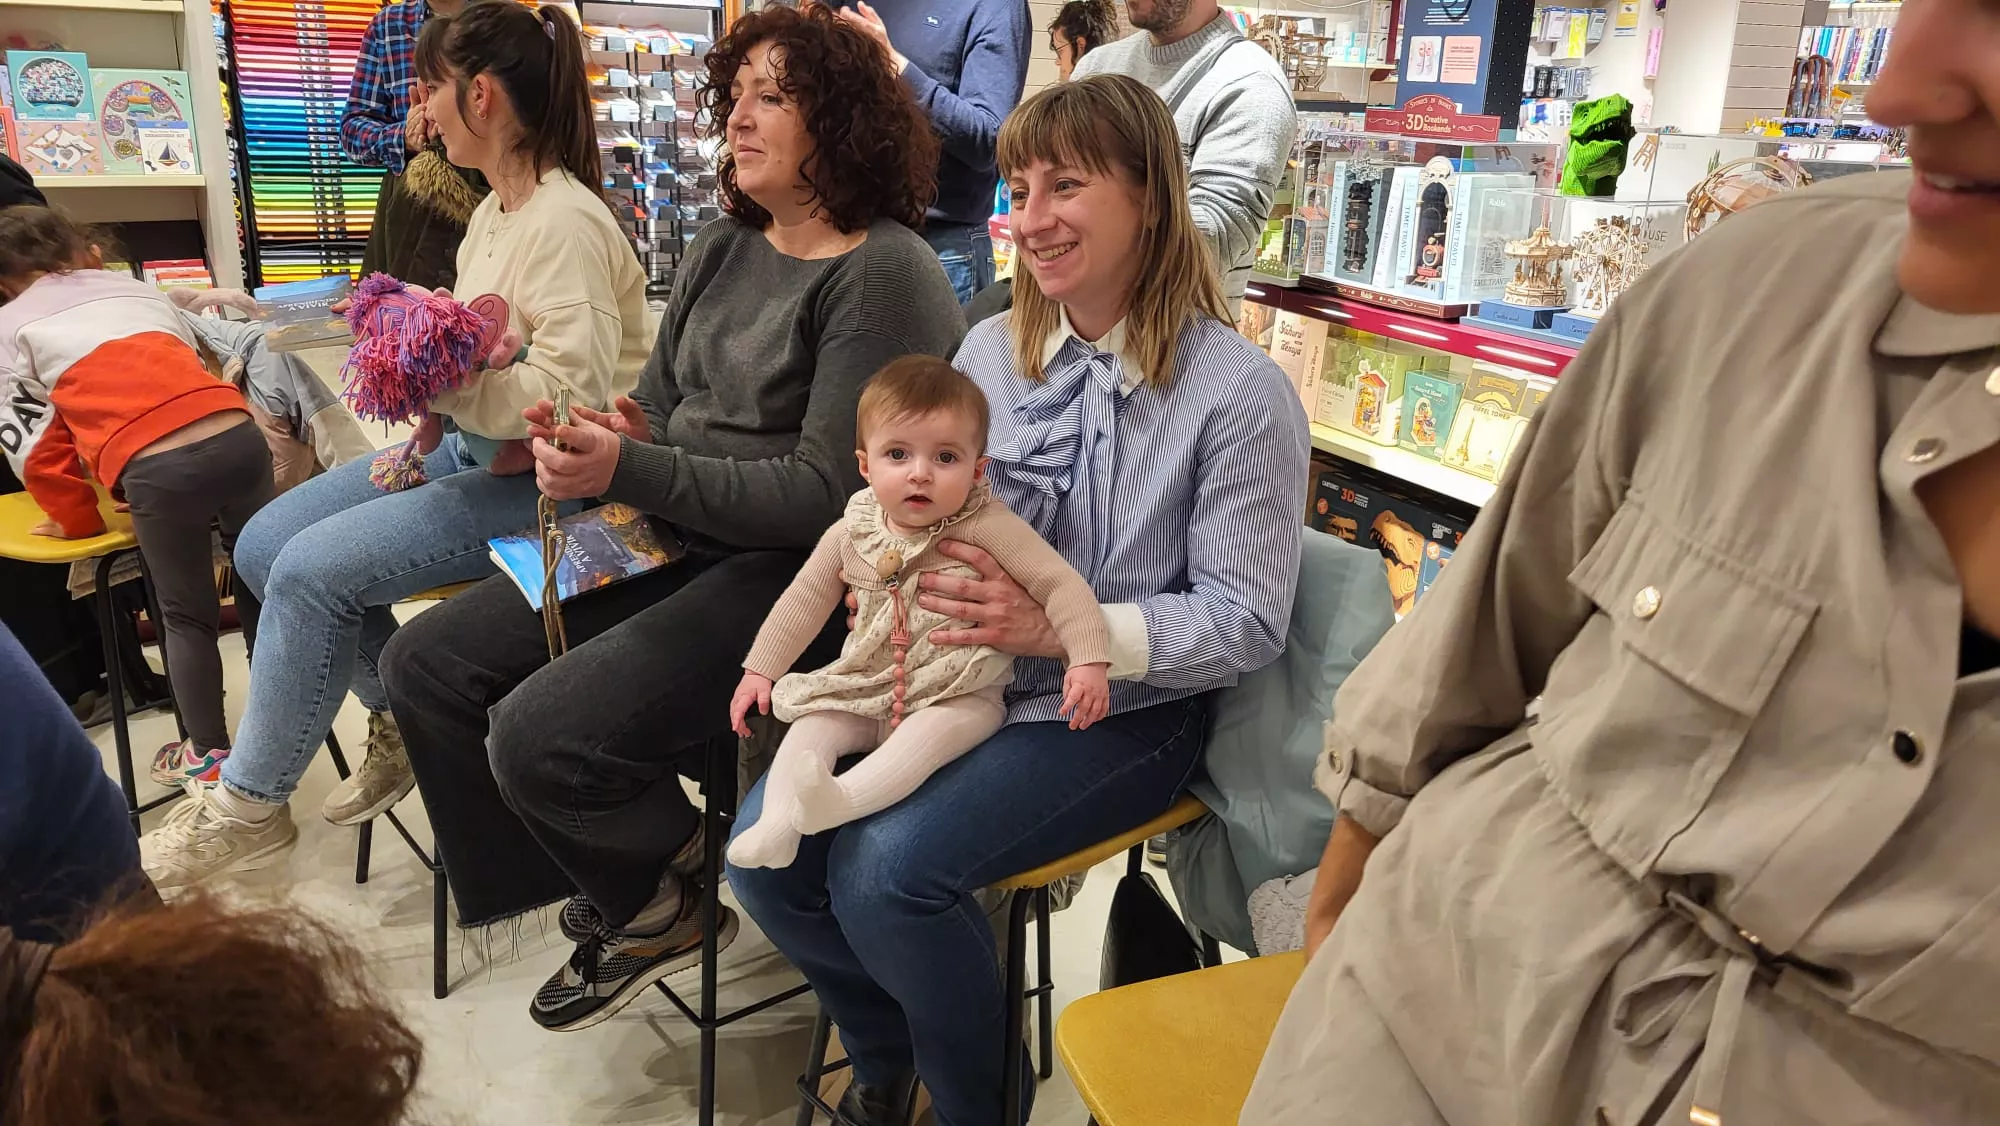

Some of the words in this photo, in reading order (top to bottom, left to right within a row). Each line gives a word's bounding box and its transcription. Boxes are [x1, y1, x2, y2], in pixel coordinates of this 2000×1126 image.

[1405, 113, 1424, 131] 3D
[1424, 114, 1448, 124] Creative
[0, 381, 48, 456] DAY
[1340, 487, 1355, 503] 3D
